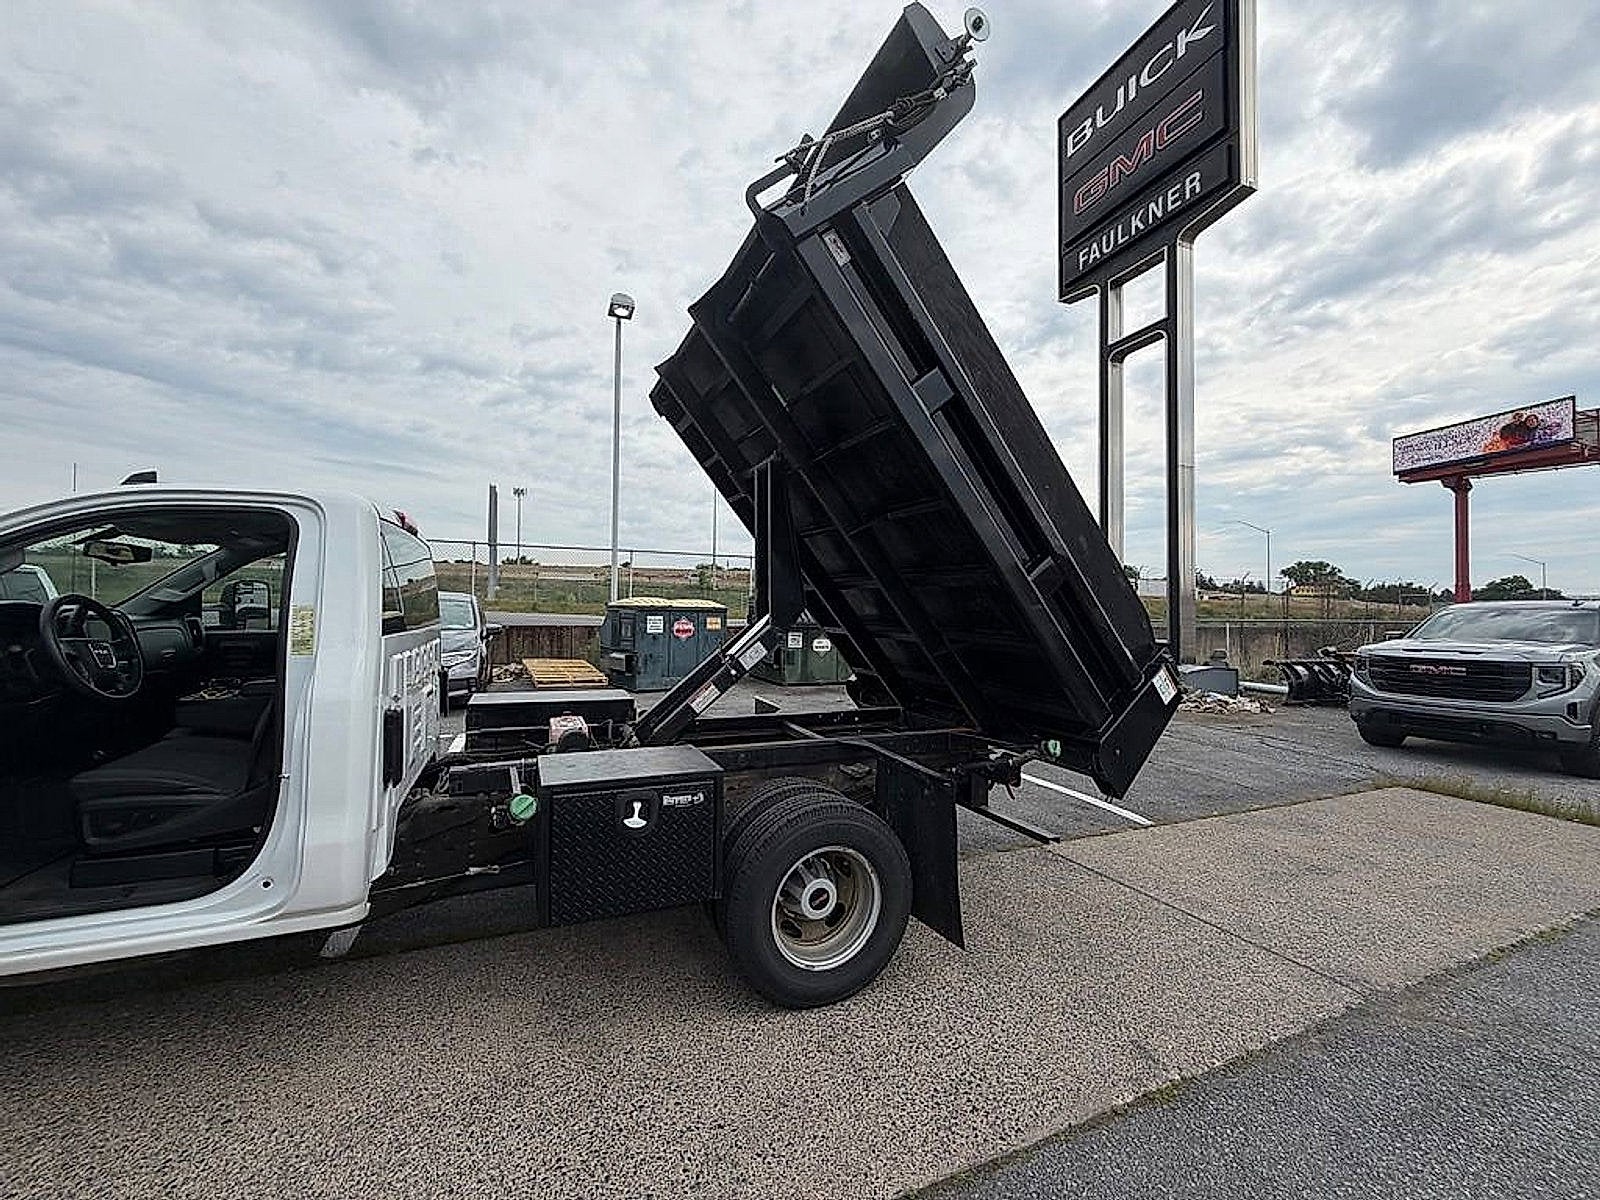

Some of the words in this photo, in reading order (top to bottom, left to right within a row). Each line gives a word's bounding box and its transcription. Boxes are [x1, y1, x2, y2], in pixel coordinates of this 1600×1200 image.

[1066, 2, 1216, 158] BUICK
[1073, 89, 1203, 215] GMC
[1078, 171, 1202, 271] FAULKNER
